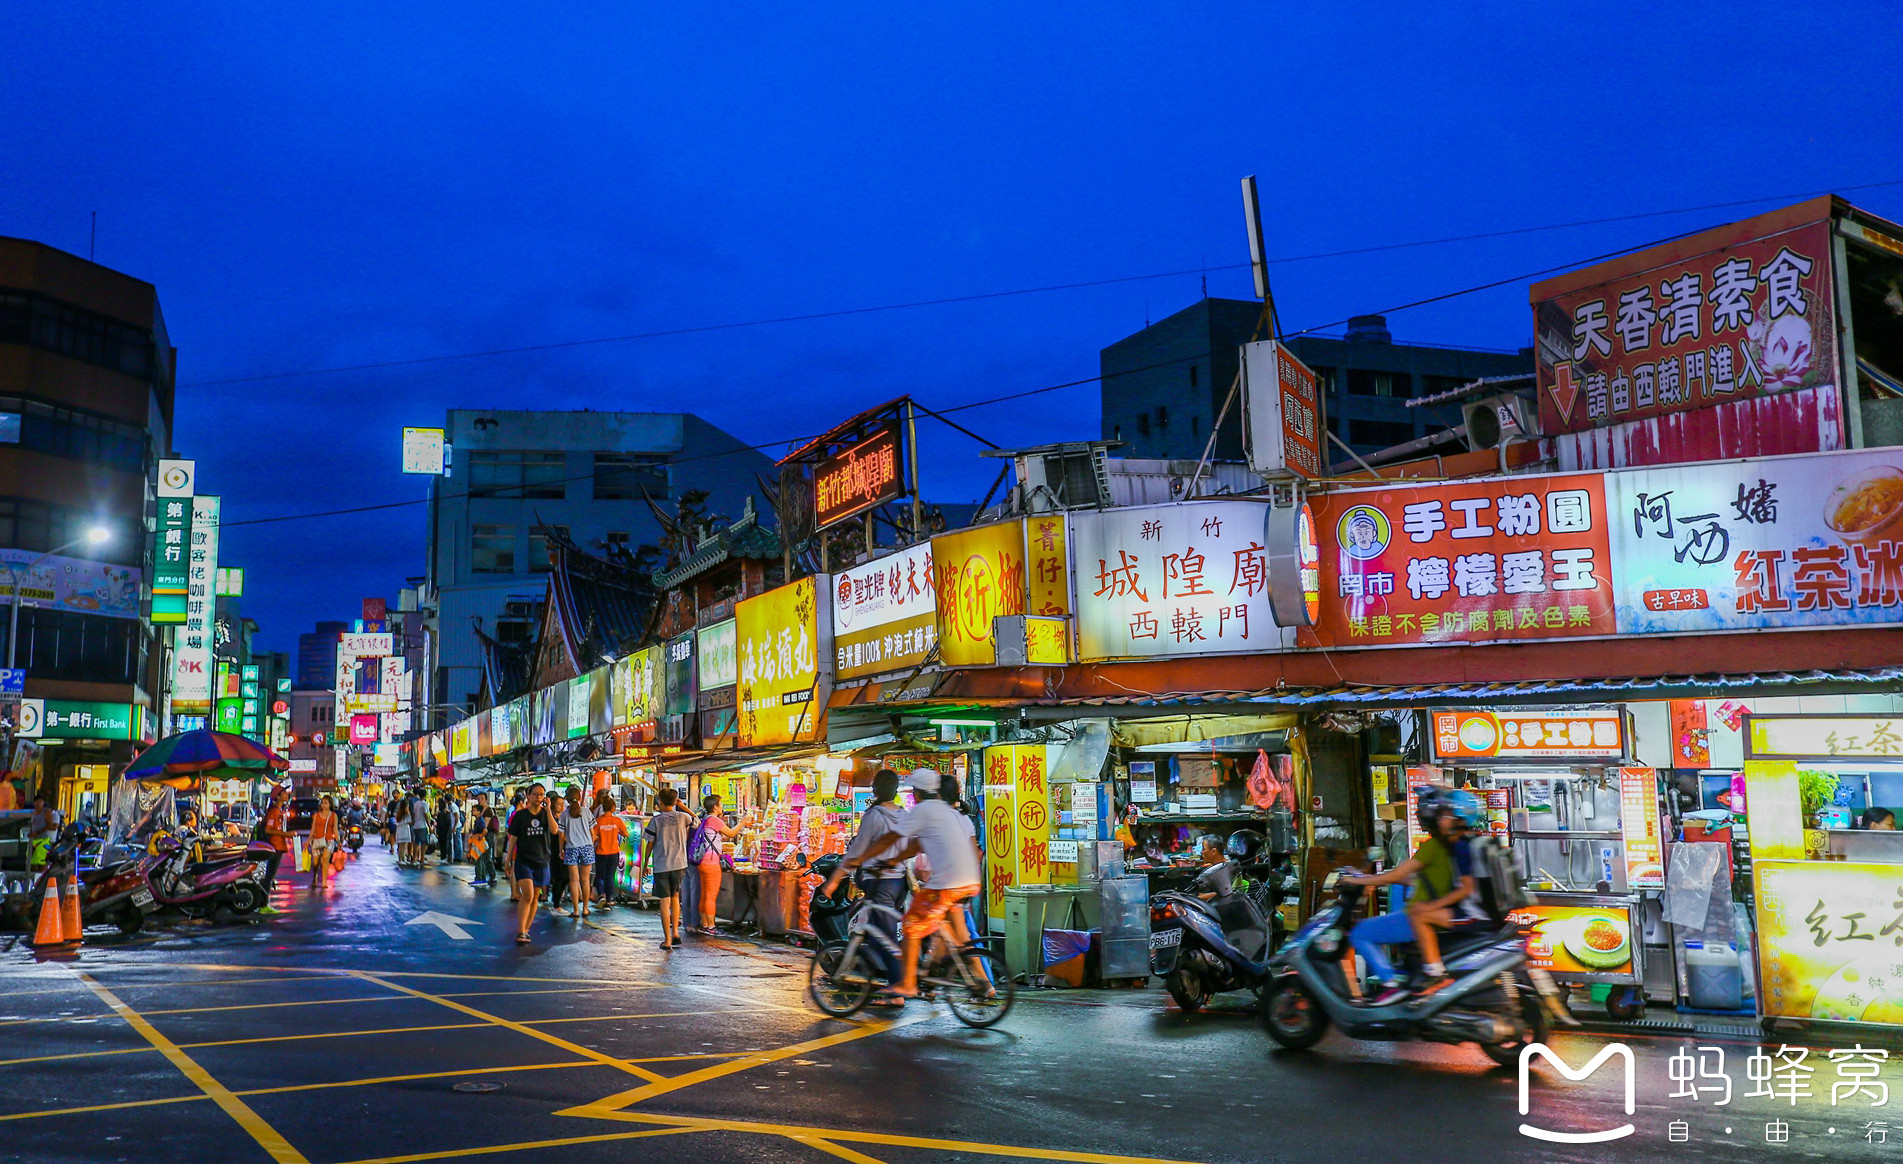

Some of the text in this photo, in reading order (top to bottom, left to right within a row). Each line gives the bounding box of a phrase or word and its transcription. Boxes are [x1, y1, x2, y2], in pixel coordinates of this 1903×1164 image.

[1572, 246, 1812, 361] 天香清素食
[1586, 339, 1763, 419] 請由西轅門進入
[817, 444, 894, 512] 新竹都城隍廟
[165, 502, 183, 561] 第一銀行
[1140, 516, 1223, 542] 新竹
[1403, 489, 1591, 543] 手工粉圓
[186, 532, 207, 649] 歐客佬咖啡農場
[853, 570, 885, 606] 聖光牌
[1093, 542, 1266, 602] 城隍廟
[1407, 548, 1598, 600] 檸檬愛玉
[1733, 541, 1903, 614] 紅茶冰
[854, 599, 885, 617] SHENG KUANG
[1129, 604, 1248, 643] 西轅門
[1349, 604, 1592, 638] 保證不含防腐劑及色素
[1650, 592, 1703, 610] 古早味
[838, 625, 938, 670] 含米量100% 沖泡式純米
[46, 711, 126, 729] 第一銀行 First Bank
